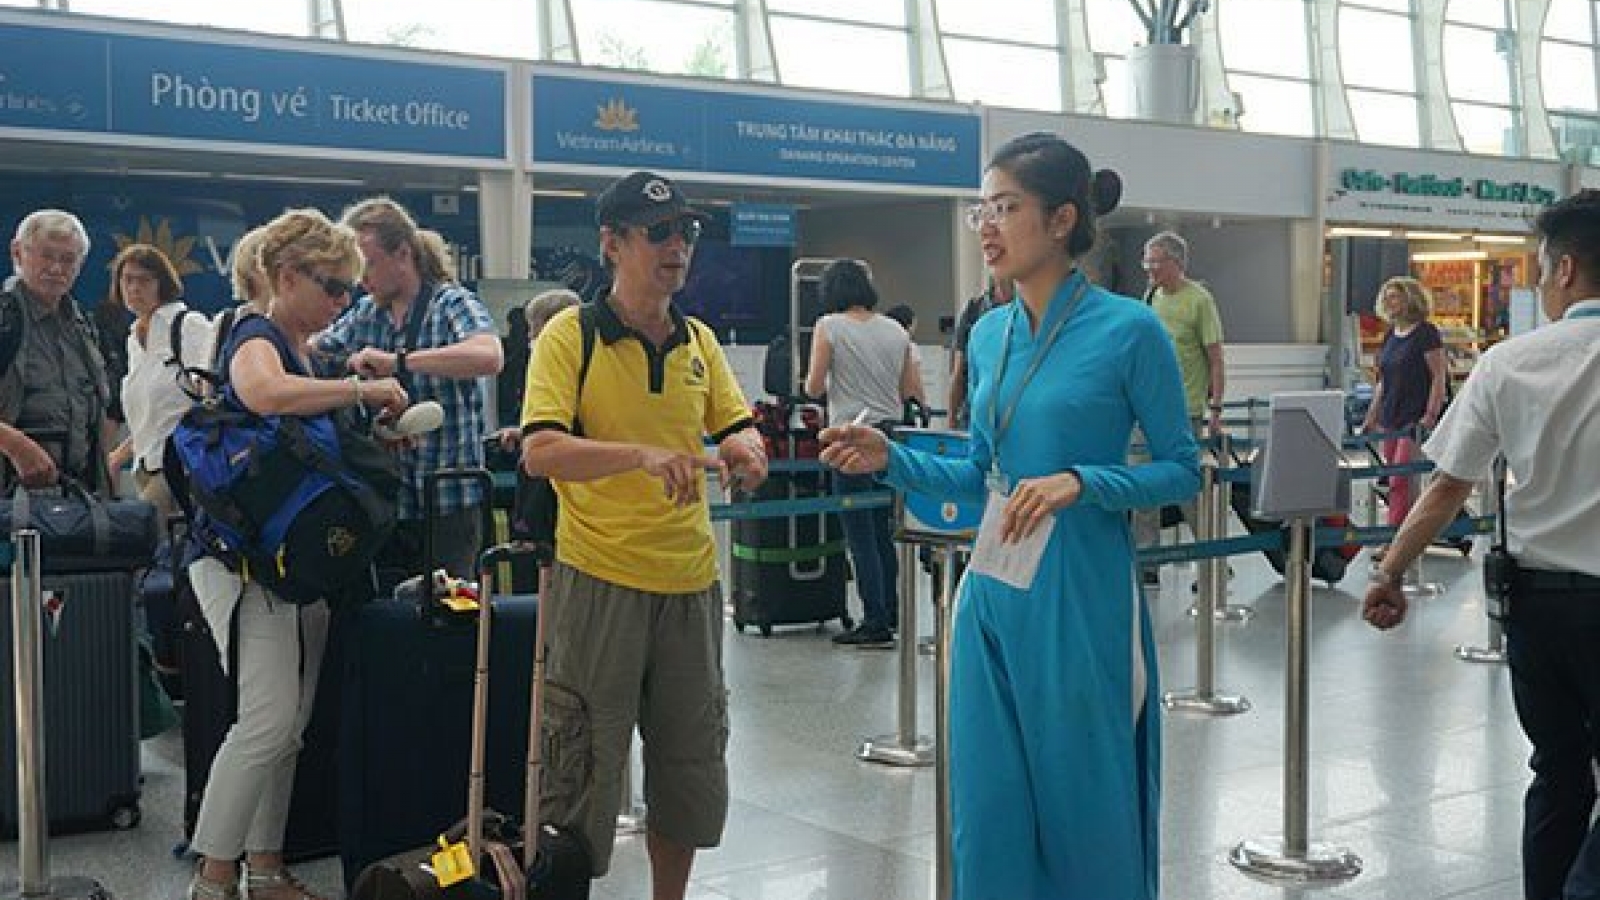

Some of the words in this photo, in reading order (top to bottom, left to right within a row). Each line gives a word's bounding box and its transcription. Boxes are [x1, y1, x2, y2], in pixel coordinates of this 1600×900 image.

[151, 72, 260, 122] Phòng
[271, 86, 308, 117] vé
[330, 94, 399, 124] Ticket
[404, 102, 470, 129] Office
[737, 121, 787, 140] TRUNG
